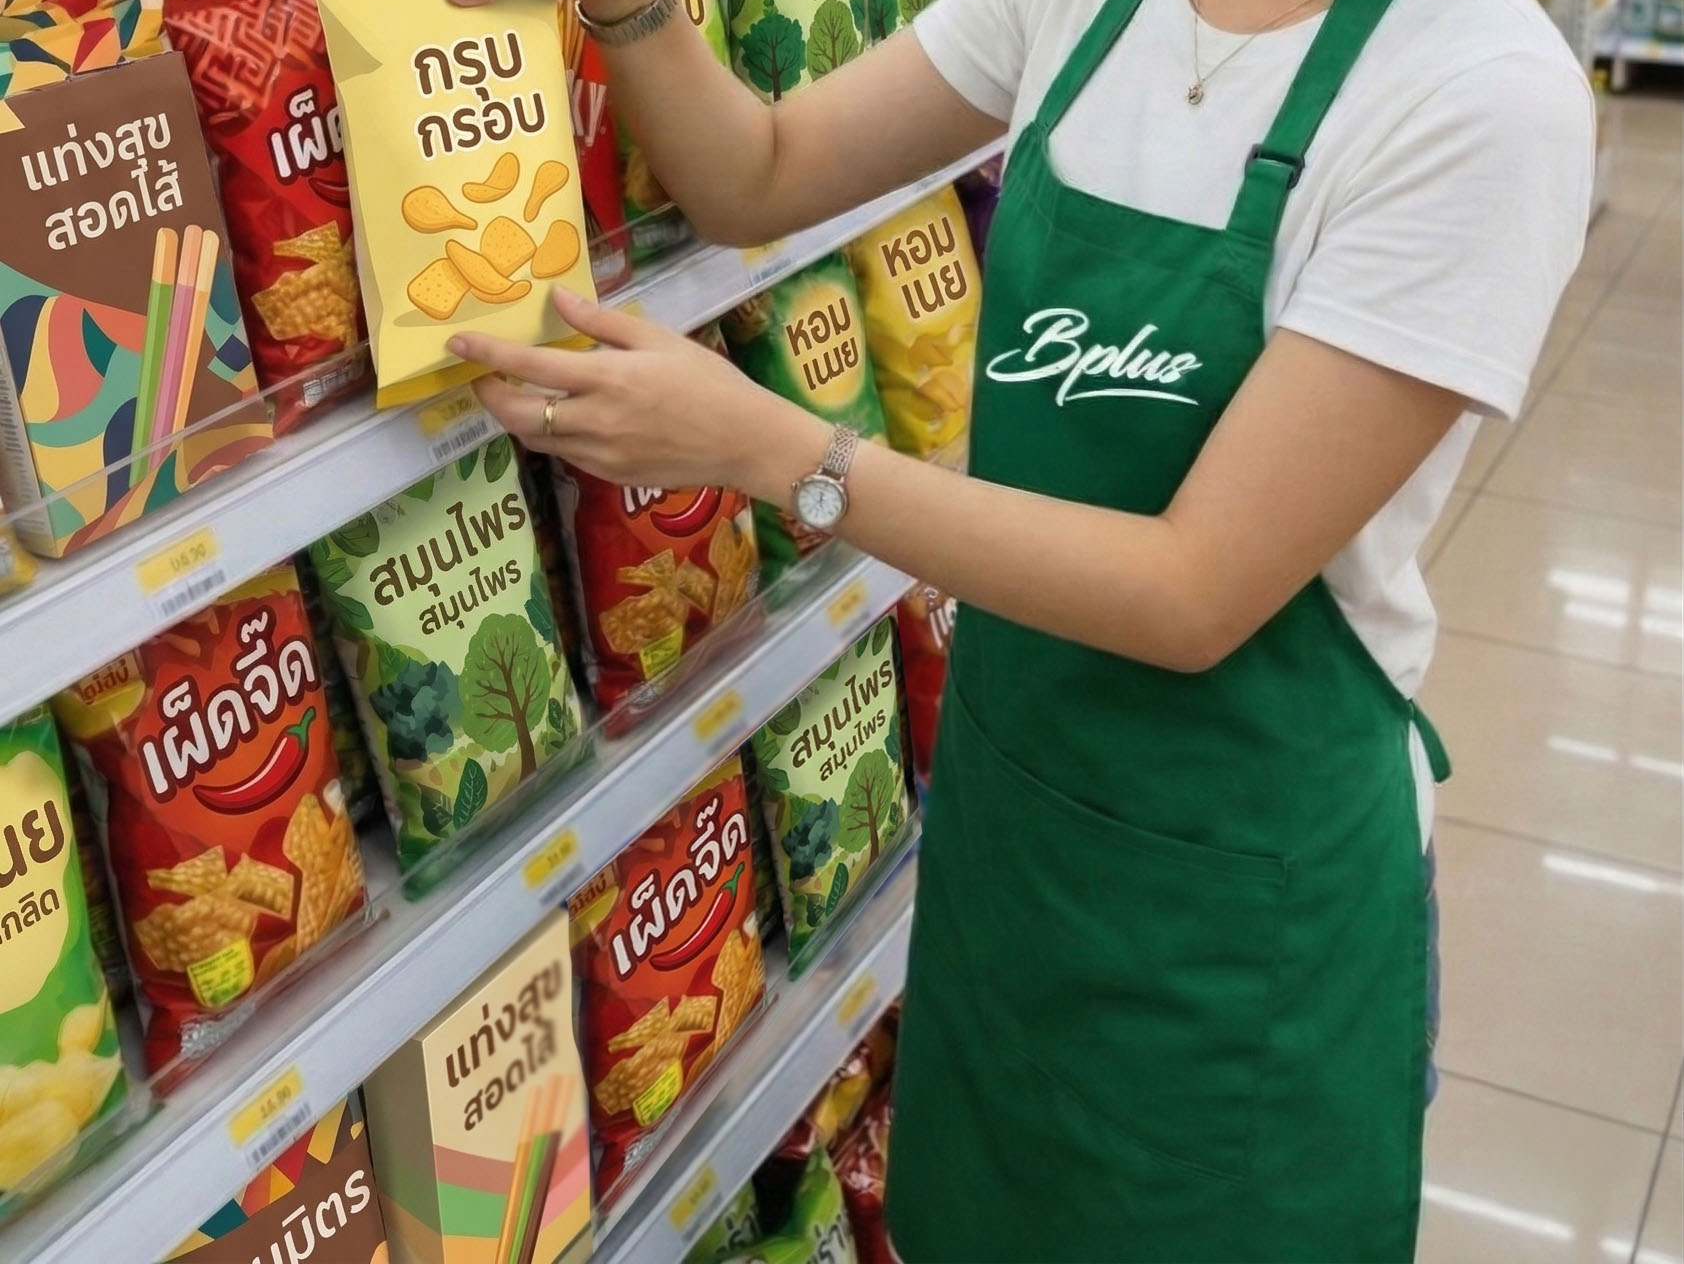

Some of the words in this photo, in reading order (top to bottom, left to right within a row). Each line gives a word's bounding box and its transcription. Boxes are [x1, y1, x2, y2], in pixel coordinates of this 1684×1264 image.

[414, 33, 522, 102] กรุบ
[21, 112, 172, 191] แท่งสุข
[417, 93, 545, 157] กรอบ
[45, 159, 183, 251] สอดไส้
[881, 217, 956, 277] หอม
[786, 297, 851, 356] หอม
[901, 260, 967, 319] เนย
[986, 308, 1203, 406] Bplus
[369, 493, 526, 606] สมุนไพร
[419, 559, 522, 635] สมุนไพร
[143, 611, 316, 804] เผ็ดจี๊ด
[790, 660, 893, 768] สมุนไพร
[819, 709, 886, 782] สมุนไพร
[0, 888, 60, 944] กลิด
[612, 798, 747, 976] เผ็ดจี๊ด
[446, 959, 563, 1088] แท่งสุข
